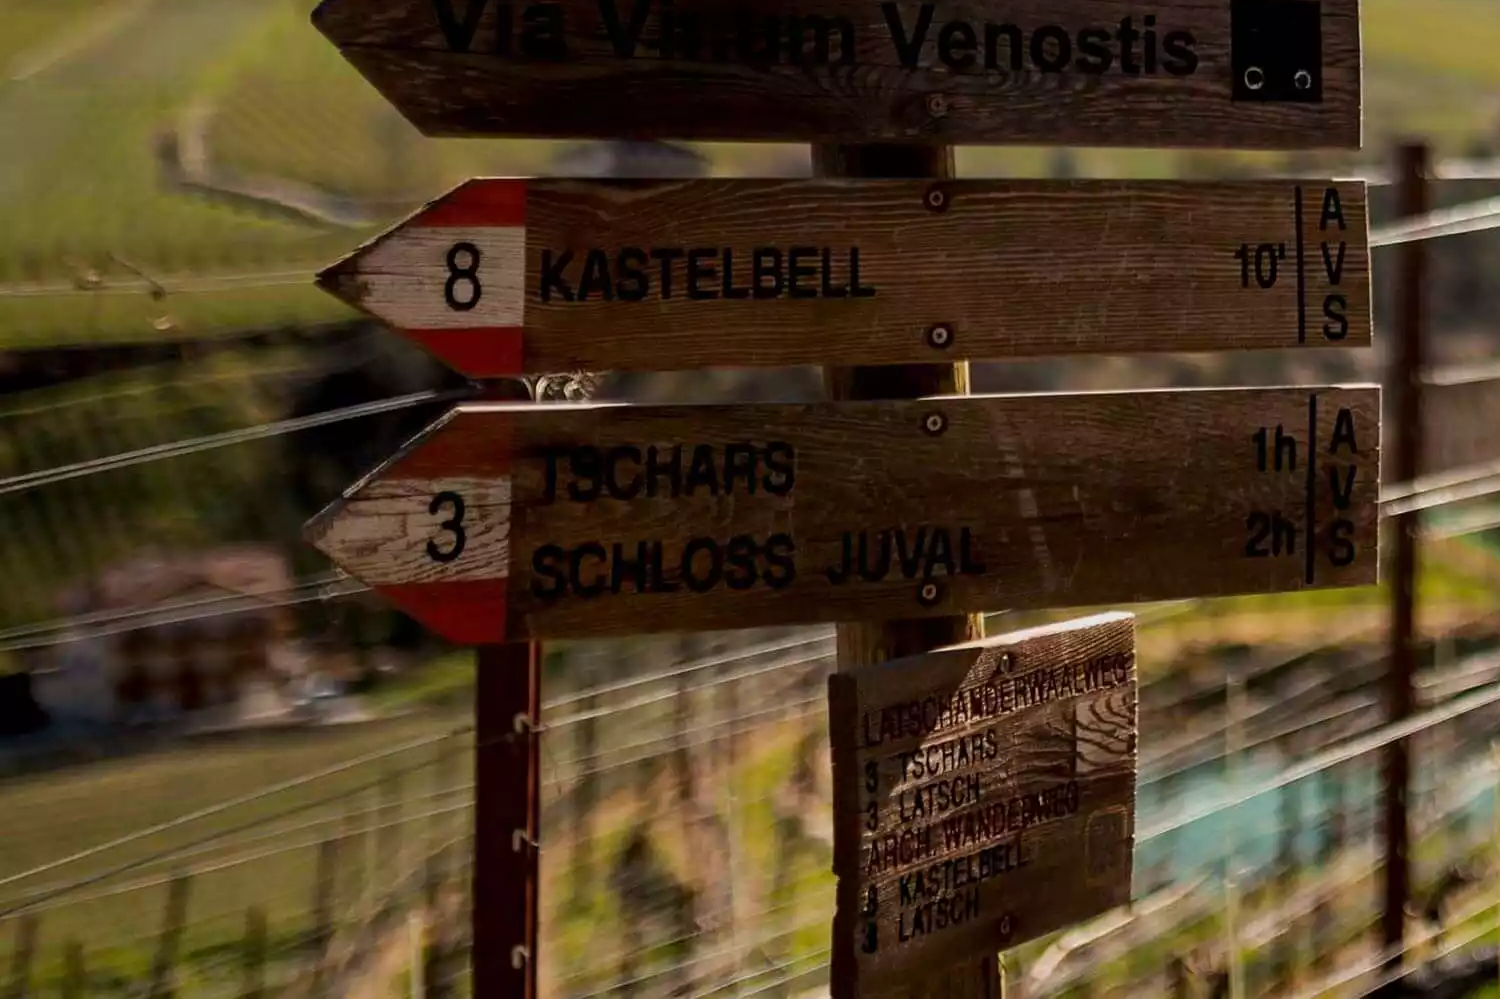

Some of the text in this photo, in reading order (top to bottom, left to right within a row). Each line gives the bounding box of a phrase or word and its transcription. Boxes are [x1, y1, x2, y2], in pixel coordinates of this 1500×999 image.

[882, 0, 1200, 76] Venostis
[443, 240, 1287, 312] 8 KASTELBELL 10'
[537, 425, 1298, 503] TSCHARS 1h
[425, 490, 467, 564] 3
[530, 509, 1296, 602] SCHLOSS JUVAL 2h
[900, 728, 998, 782] TSCHARS
[866, 774, 981, 832] 3 LATSCH
[900, 843, 1028, 906] KASTELBELL
[899, 888, 980, 943] LATSCH
